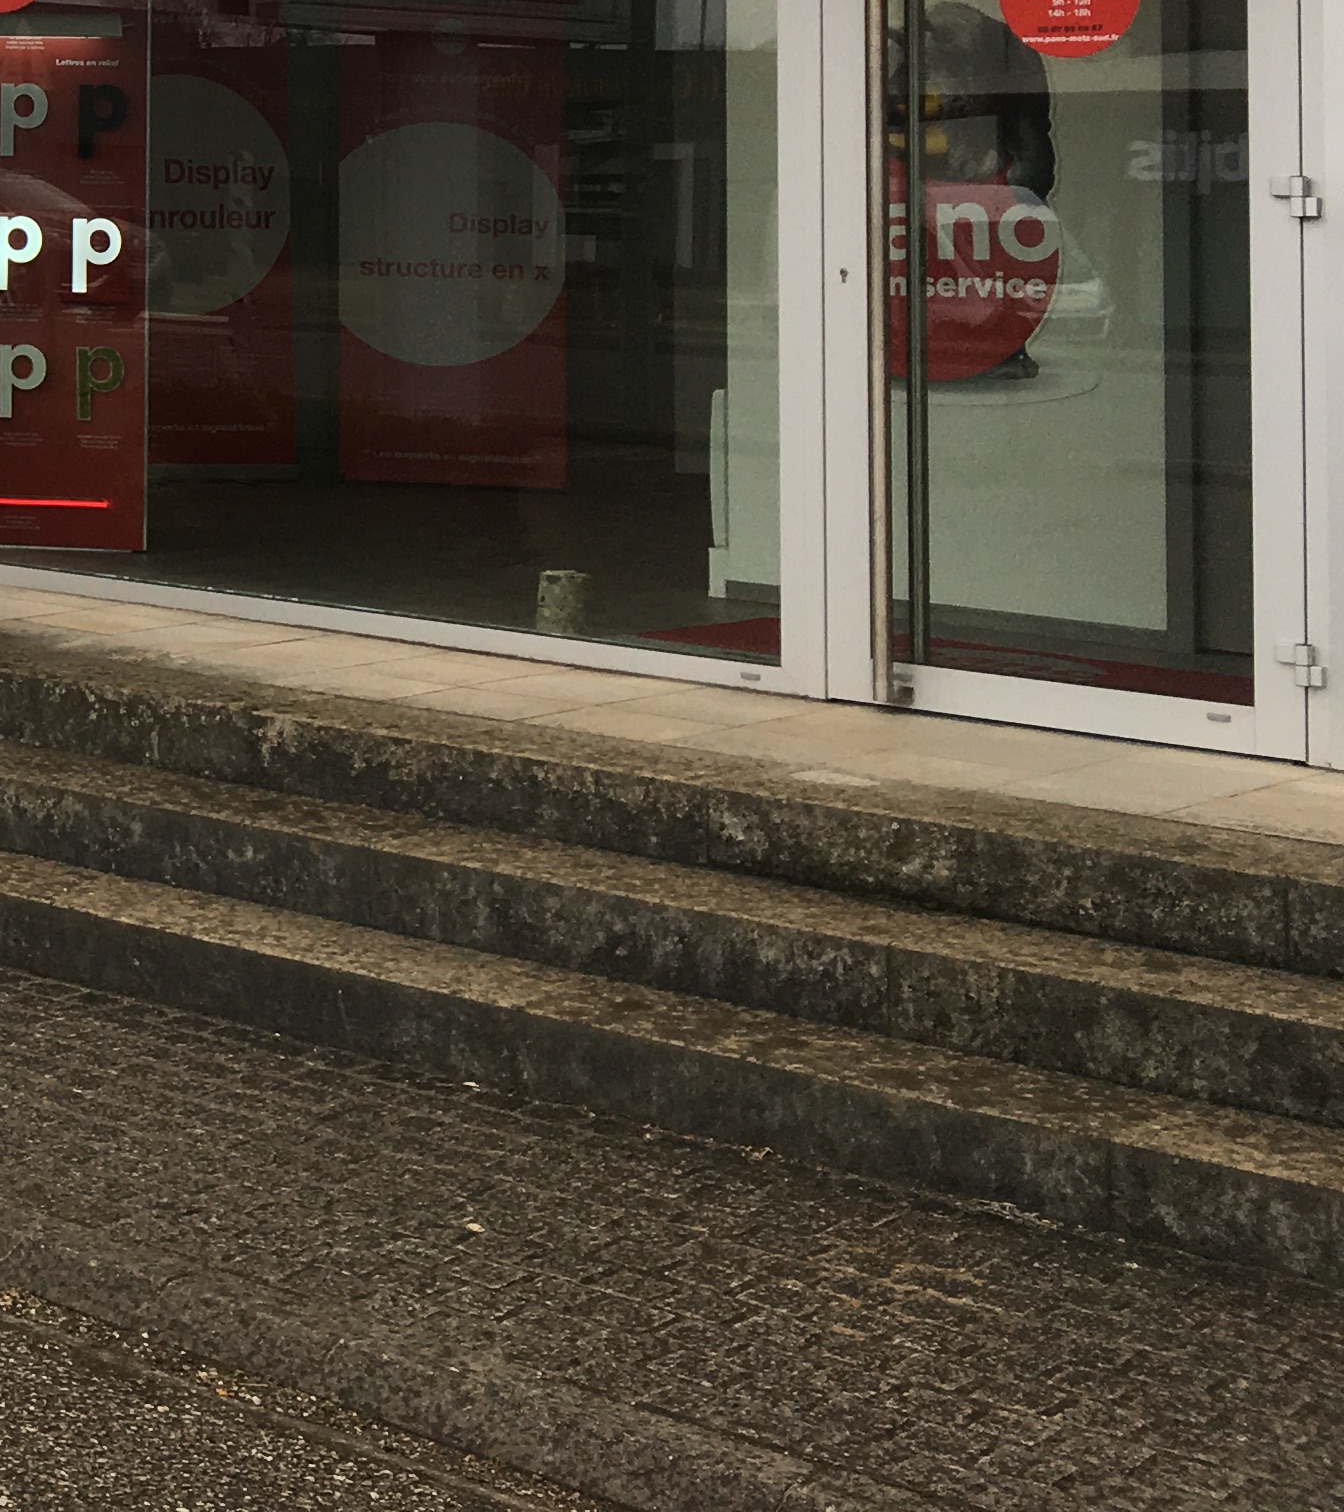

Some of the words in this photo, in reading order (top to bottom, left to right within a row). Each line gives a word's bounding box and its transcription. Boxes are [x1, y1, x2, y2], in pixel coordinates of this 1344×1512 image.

[0, 83, 48, 157] p
[79, 84, 128, 159] p
[164, 158, 275, 191] Display
[149, 204, 276, 230] nrouleur
[449, 213, 548, 238] Display
[889, 202, 1060, 262] ano
[71, 218, 122, 293] p
[359, 258, 483, 279] structure
[492, 262, 525, 280] en
[534, 264, 550, 280] x
[76, 346, 125, 421] p
